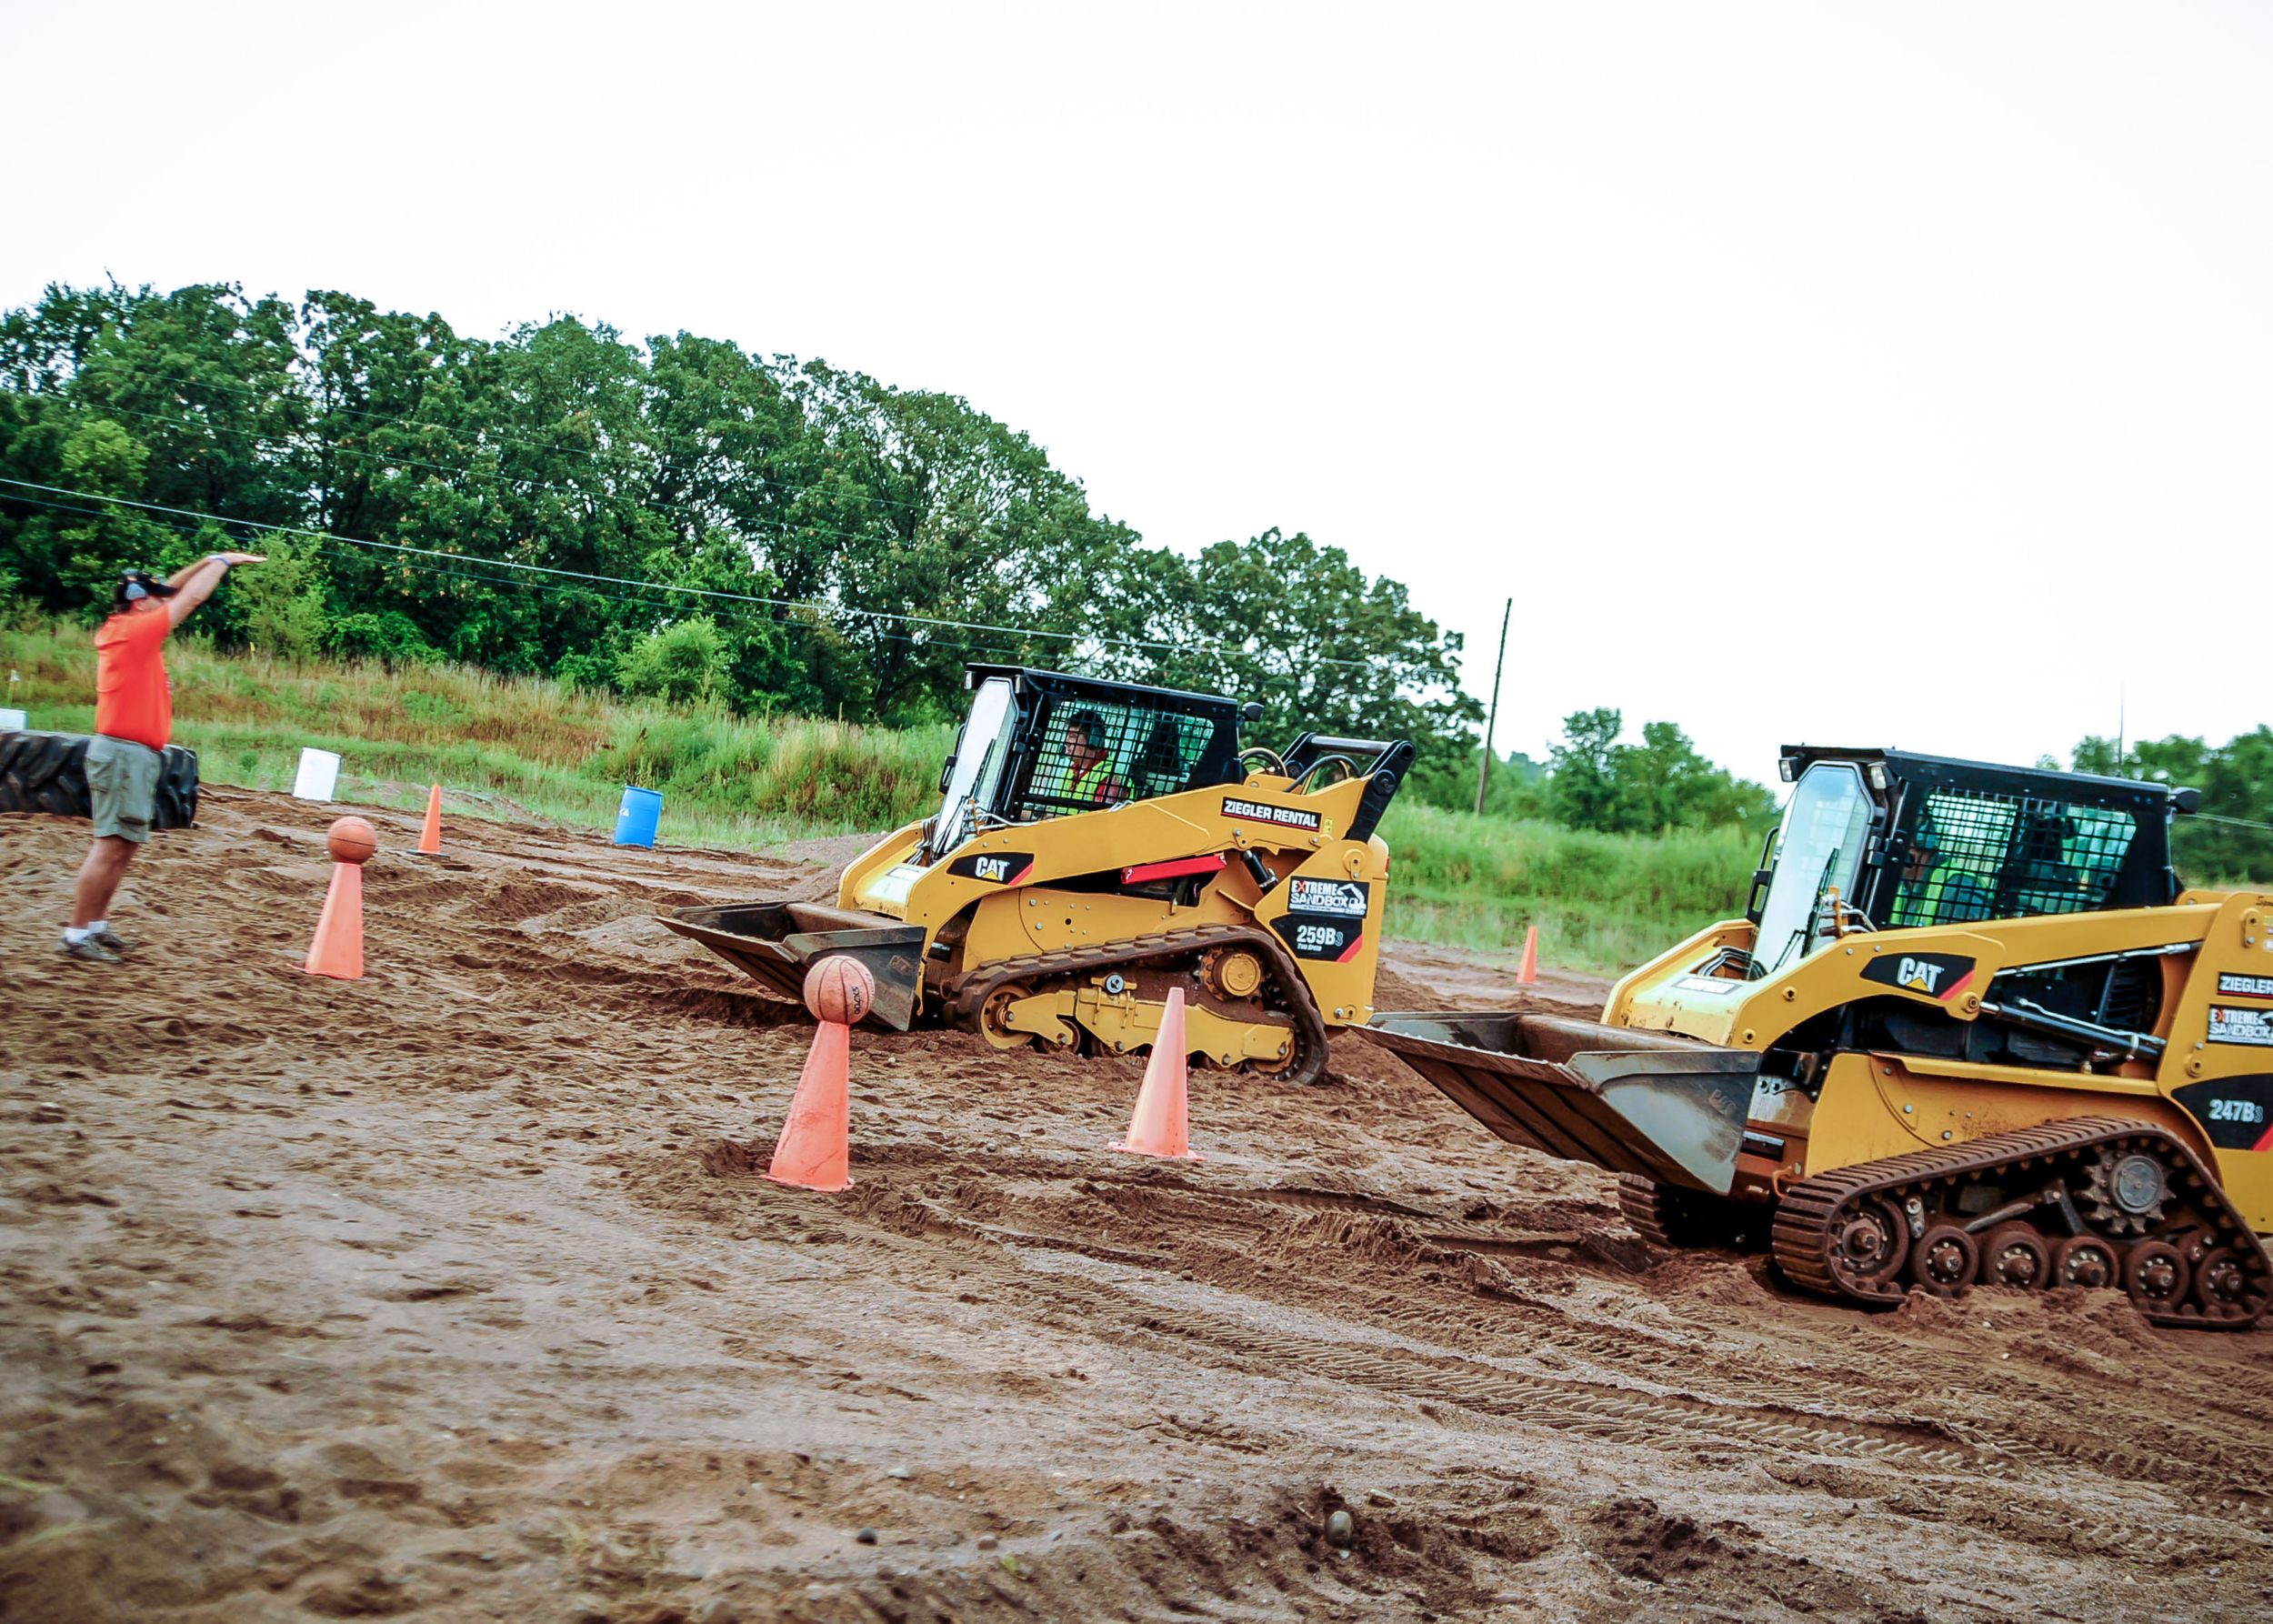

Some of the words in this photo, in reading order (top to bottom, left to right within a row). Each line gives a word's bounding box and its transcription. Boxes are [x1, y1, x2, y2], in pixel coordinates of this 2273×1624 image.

[1224, 800, 1272, 820] ZIEGLER
[1273, 808, 1317, 827] RENTAL
[975, 857, 1008, 881] CAT
[1291, 879, 1338, 896] EXTREME
[1290, 893, 1348, 907] SANDBOX
[1897, 957, 1942, 993] CAT
[2209, 1008, 2259, 1025] EXTREME
[2208, 1023, 2269, 1038] SANDBOX
